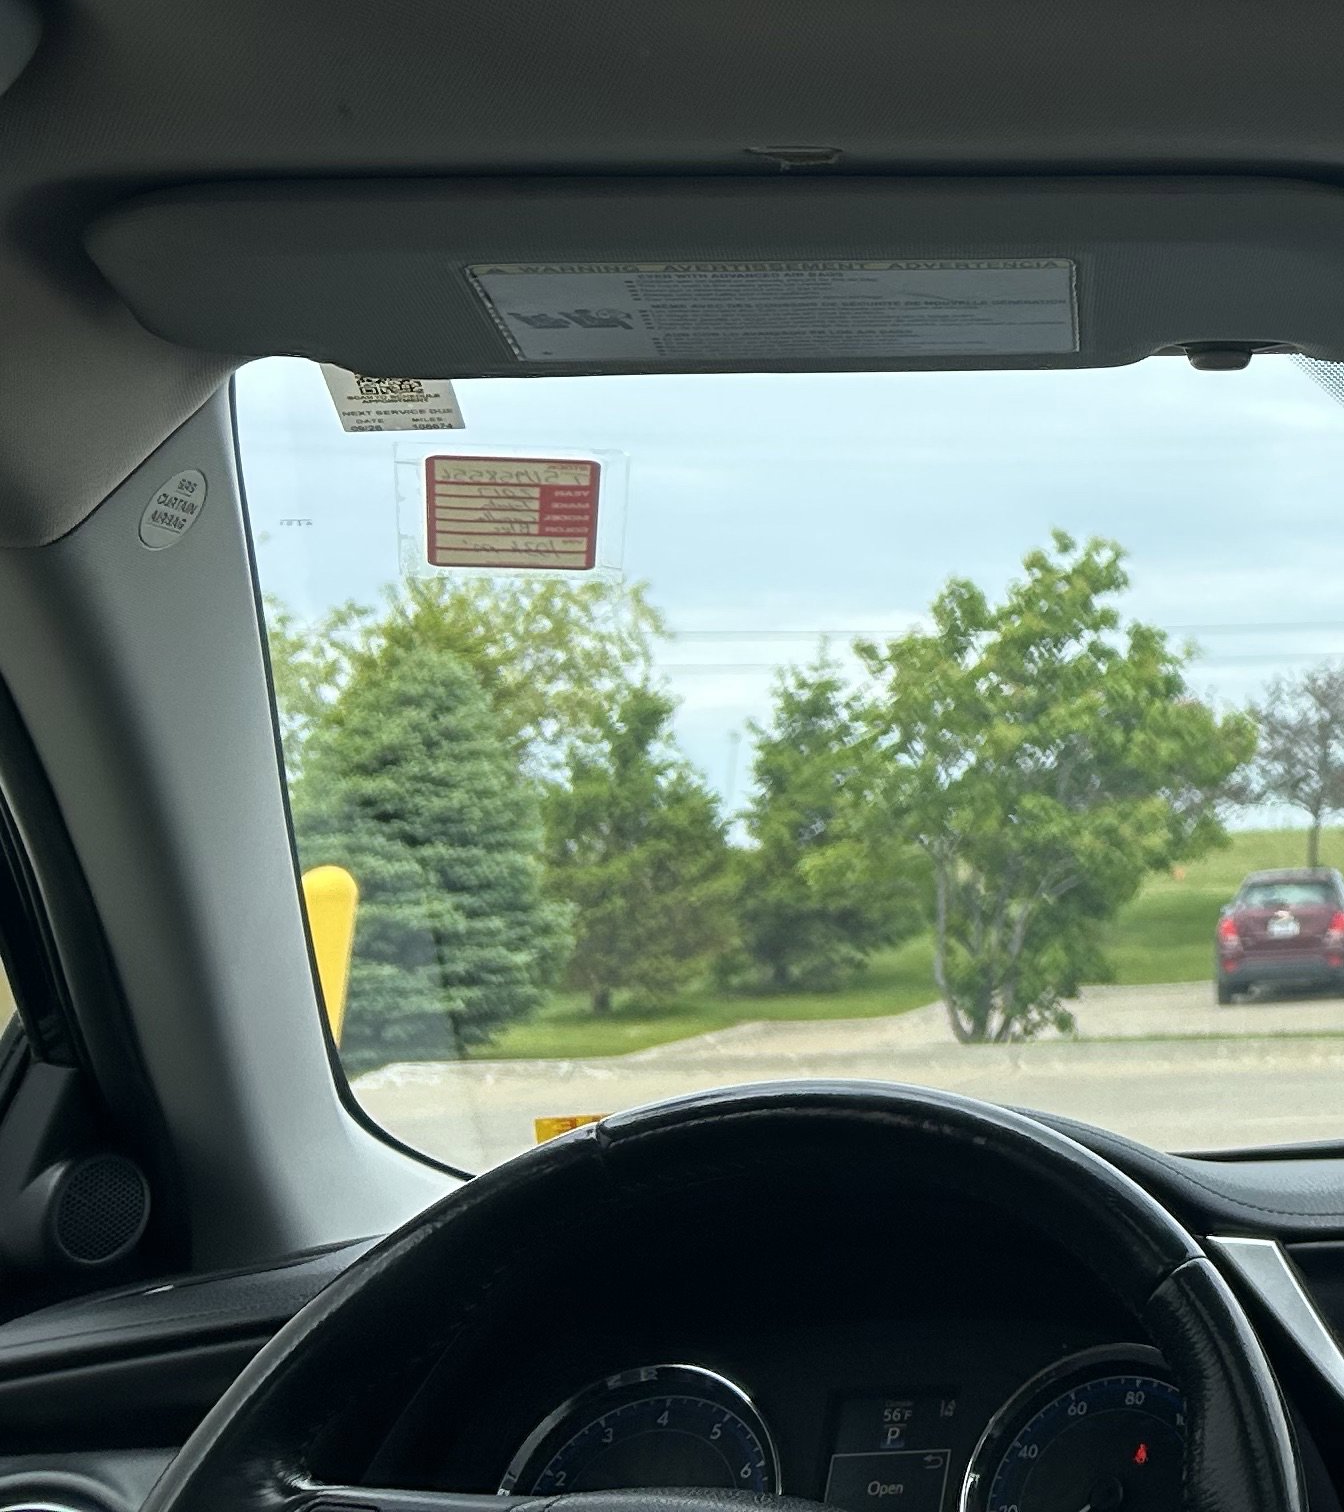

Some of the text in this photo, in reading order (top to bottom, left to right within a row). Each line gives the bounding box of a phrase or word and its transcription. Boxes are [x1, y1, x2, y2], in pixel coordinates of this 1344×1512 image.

[518, 265, 638, 274] WARNING
[888, 261, 1060, 270] ADVERTENCIA
[1124, 1391, 1146, 1406] 80
[1067, 1401, 1088, 1417] 60
[656, 1410, 670, 1427] 4
[601, 1427, 615, 1444] 3
[709, 1423, 722, 1440] 5
[886, 1426, 901, 1445] P
[1017, 1443, 1039, 1459] 40
[554, 1471, 568, 1487] 2
[739, 1462, 753, 1479] 6
[867, 1480, 904, 1498] Open
